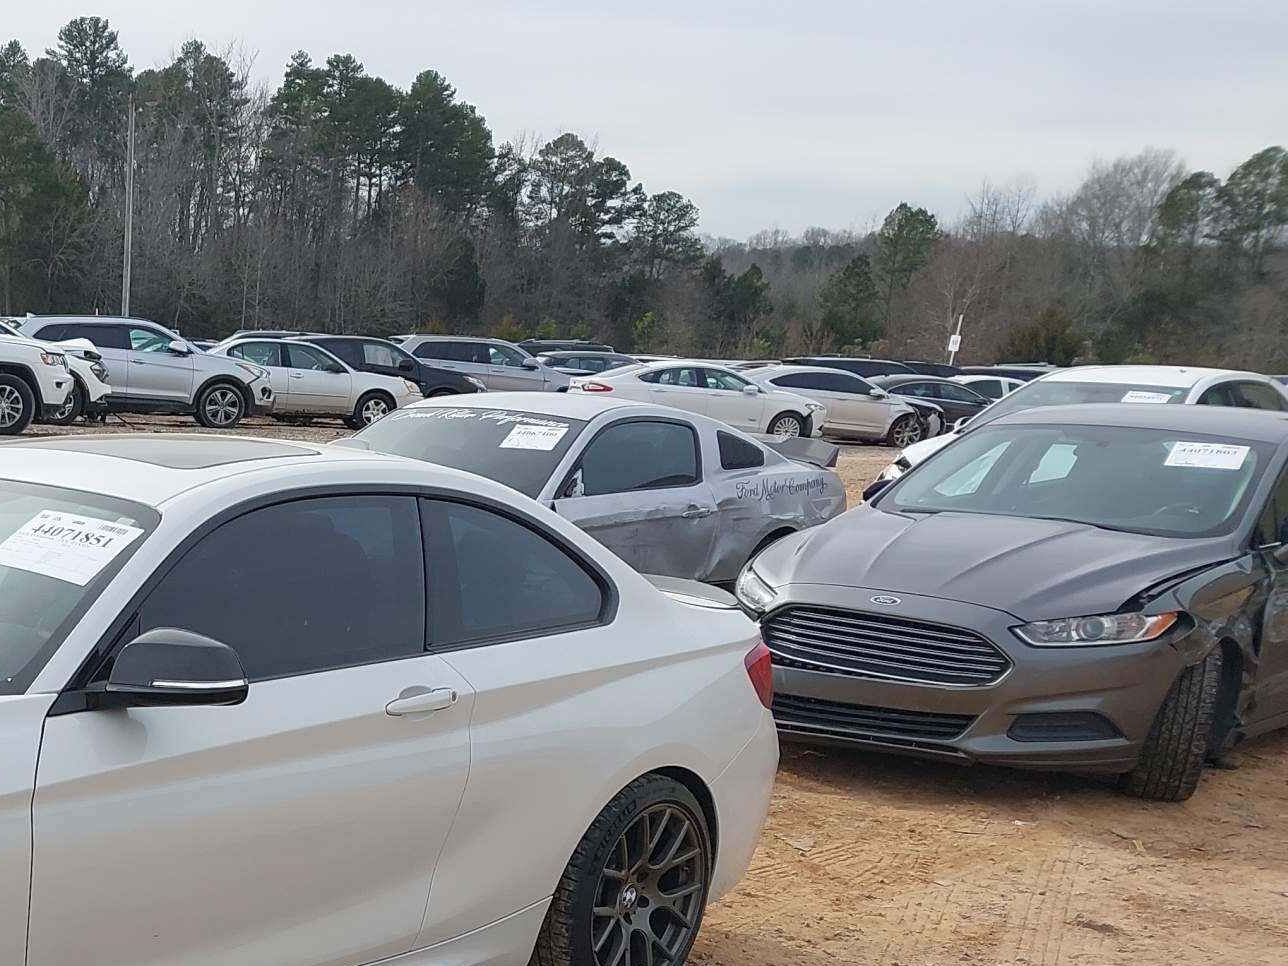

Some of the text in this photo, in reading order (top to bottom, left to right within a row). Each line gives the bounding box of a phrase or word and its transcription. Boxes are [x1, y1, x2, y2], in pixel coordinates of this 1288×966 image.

[736, 477, 828, 501] Ford Motor Company
[32, 523, 114, 548] 44071851
